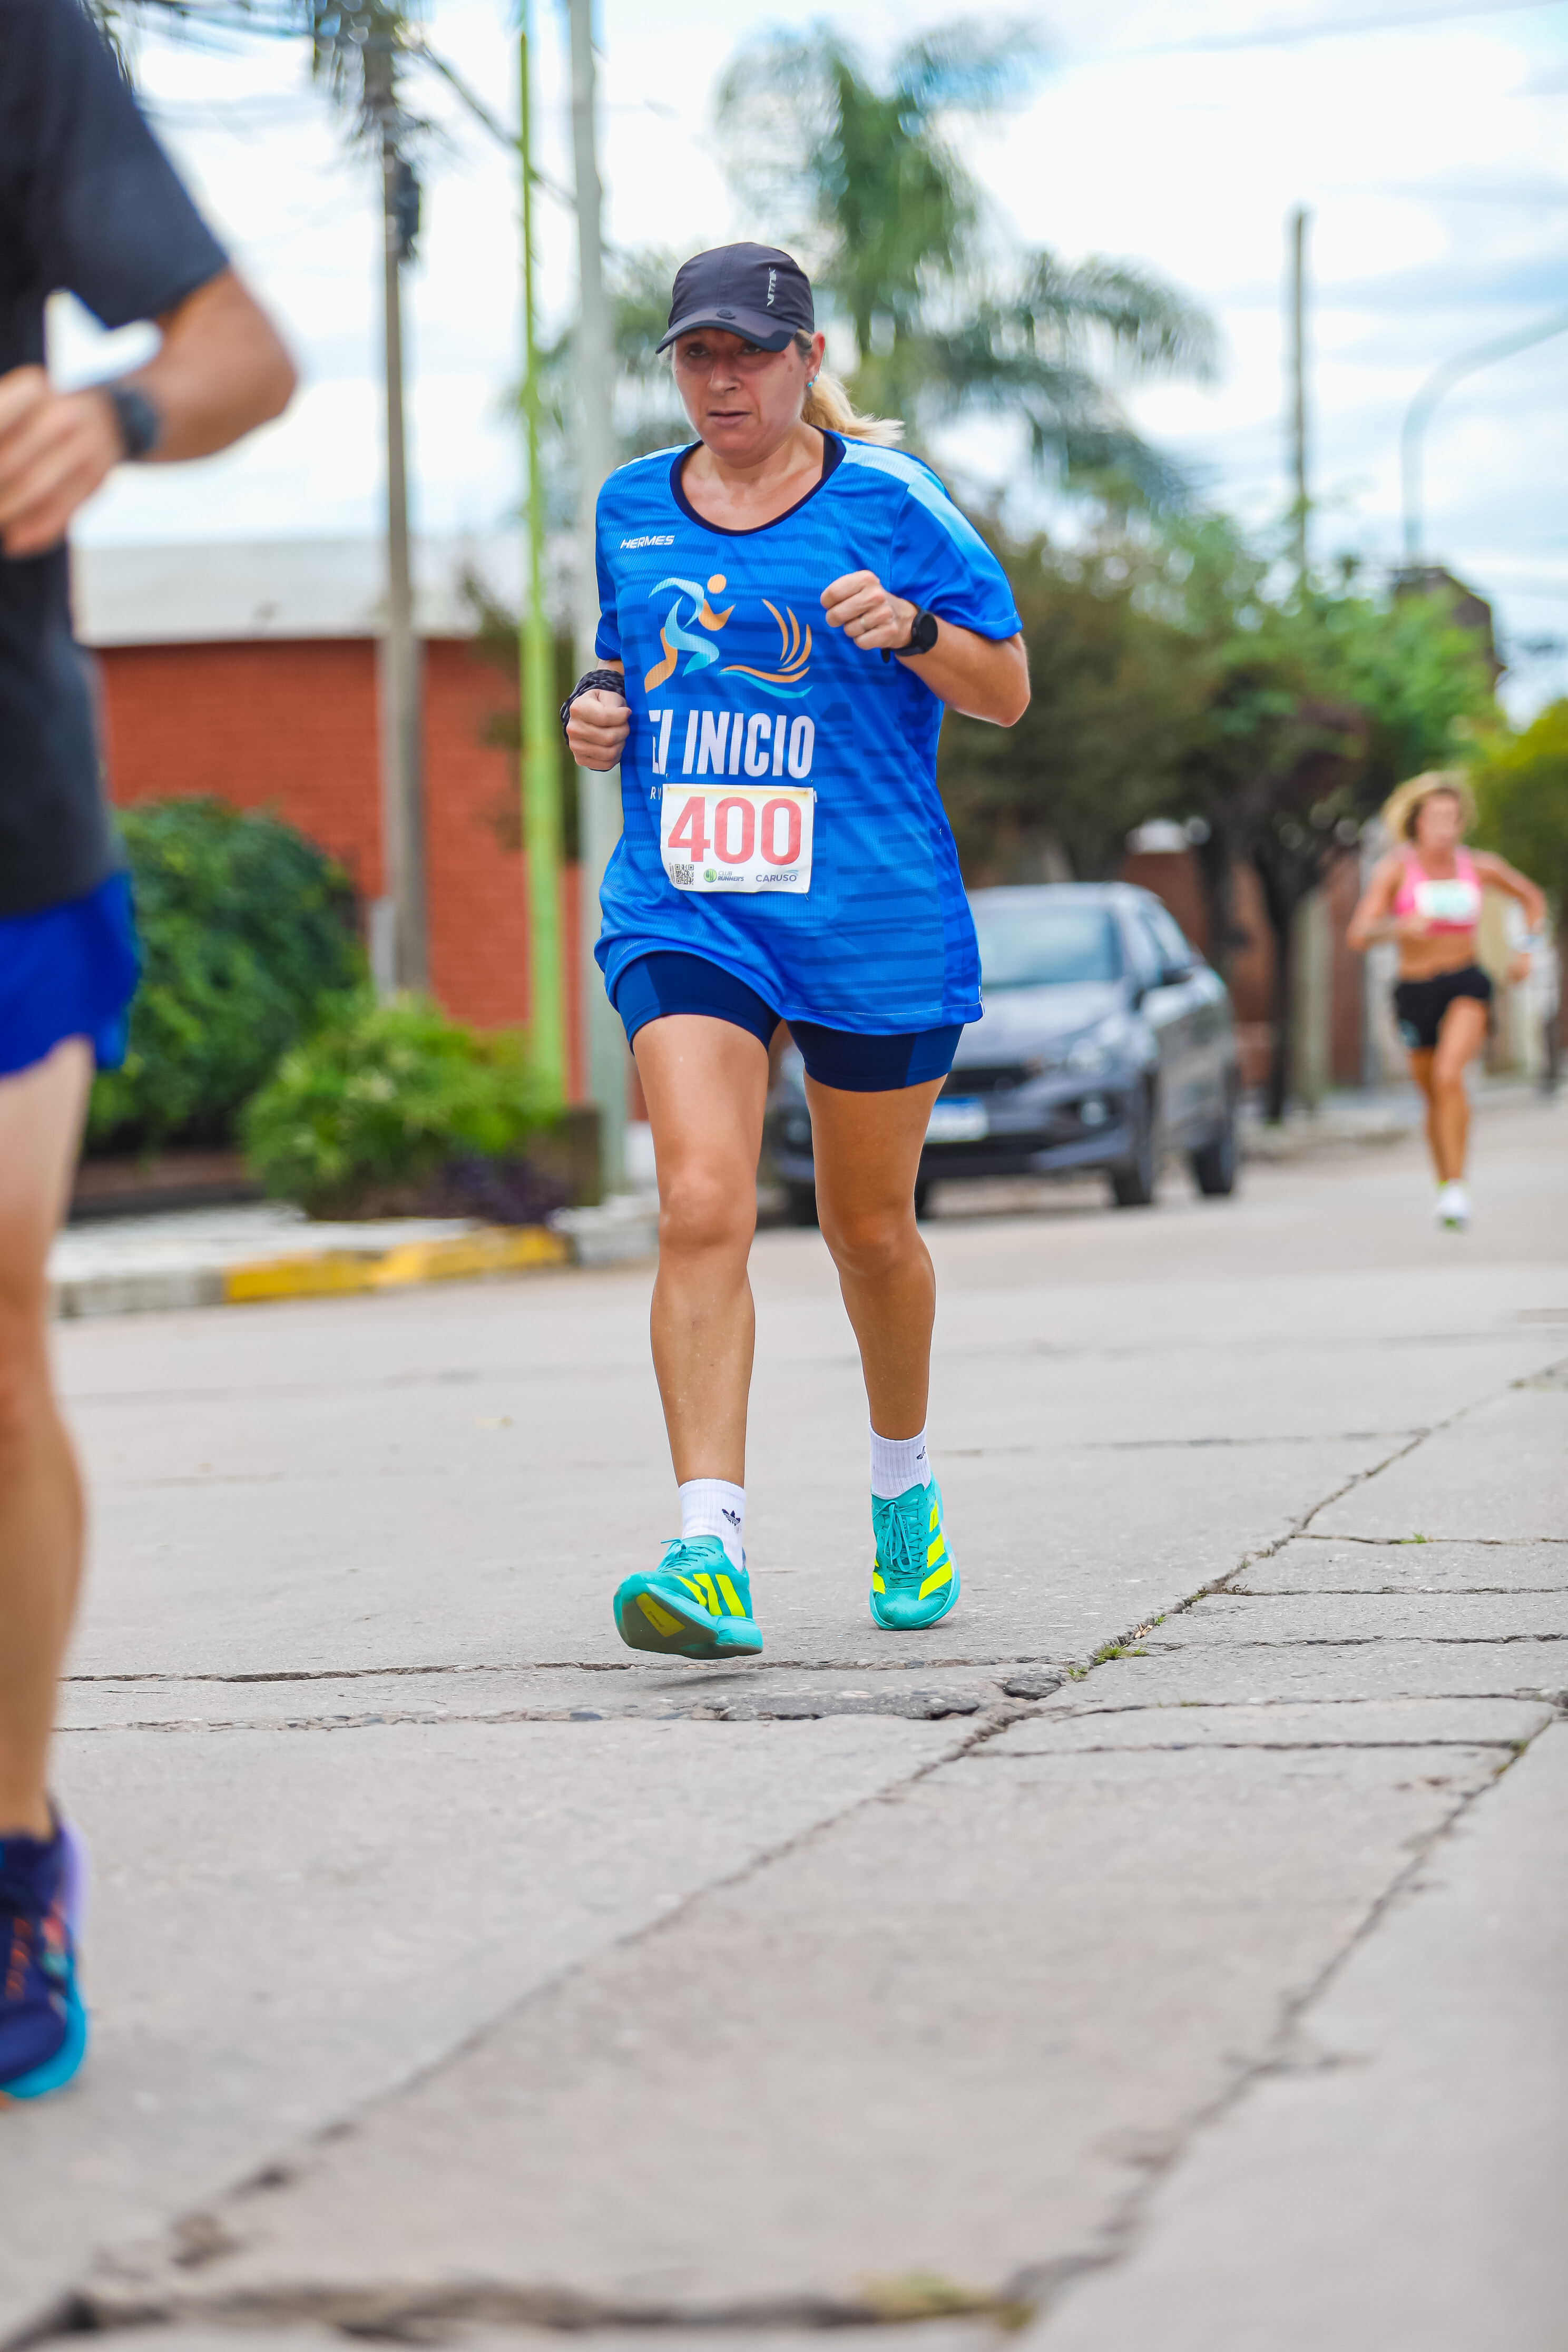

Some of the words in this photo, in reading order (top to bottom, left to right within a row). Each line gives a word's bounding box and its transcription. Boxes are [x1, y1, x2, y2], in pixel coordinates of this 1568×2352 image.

[620, 535, 675, 550] HERMES
[682, 709, 815, 779] INICIO
[668, 796, 801, 865] 400
